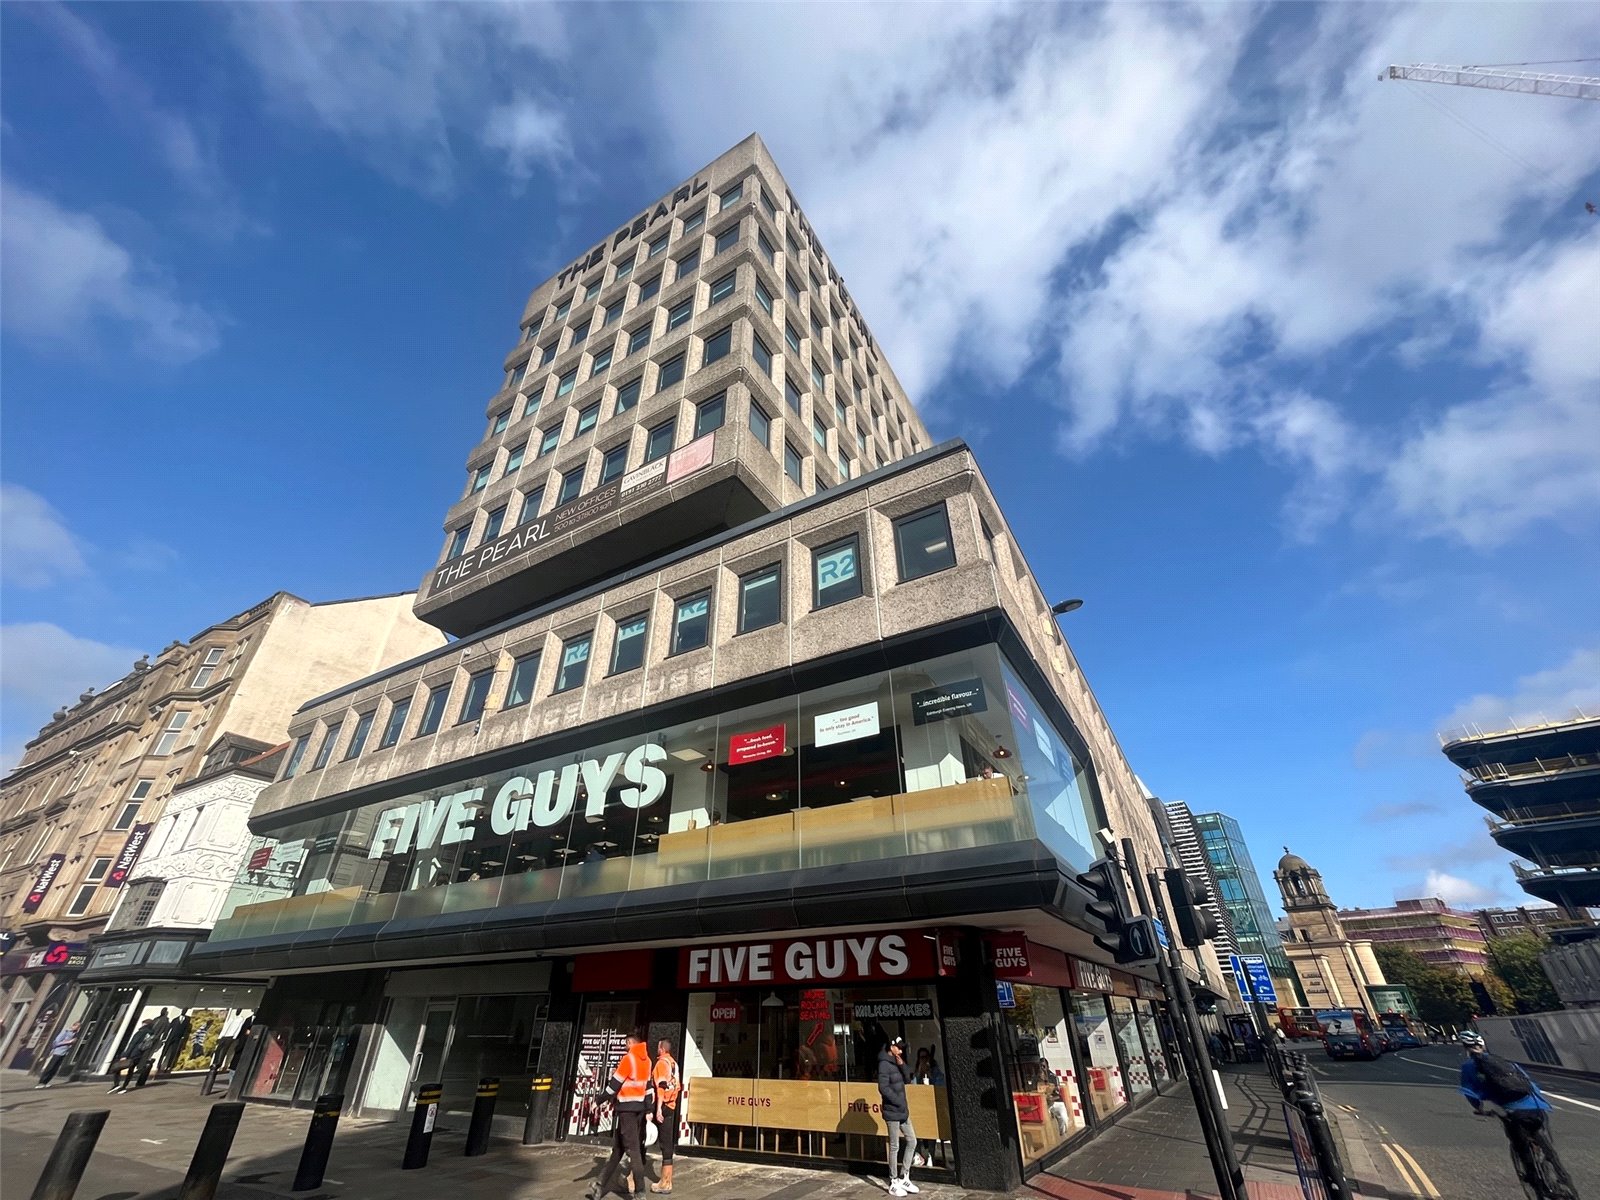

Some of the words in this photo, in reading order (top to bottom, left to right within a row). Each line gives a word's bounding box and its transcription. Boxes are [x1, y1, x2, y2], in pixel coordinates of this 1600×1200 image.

[557, 243, 606, 290] THE
[612, 177, 708, 252] PEARL
[555, 507, 577, 521] NEW
[577, 486, 617, 511] OFFICES
[436, 554, 475, 588] THE
[478, 519, 550, 569] PEARL
[821, 554, 854, 583] R2
[566, 643, 589, 662] R2
[368, 787, 484, 860] FIVE
[490, 743, 668, 836] GUYS
[117, 830, 145, 869] NatWest
[35, 859, 61, 893] NatWest
[943, 945, 954, 956] FIVE
[996, 947, 1022, 958] FIVE
[689, 944, 774, 984] FIVE
[784, 935, 910, 980] GUYS
[943, 955, 956, 966] GUYS
[995, 957, 1027, 968] GUYS
[712, 1007, 736, 1019] OPEN
[799, 1010, 831, 1020] SEATING
[855, 1003, 931, 1018] MILKSHAKES
[727, 1096, 746, 1106] FIVE
[747, 1097, 771, 1107] GUYS
[848, 1102, 869, 1113] FIVE
